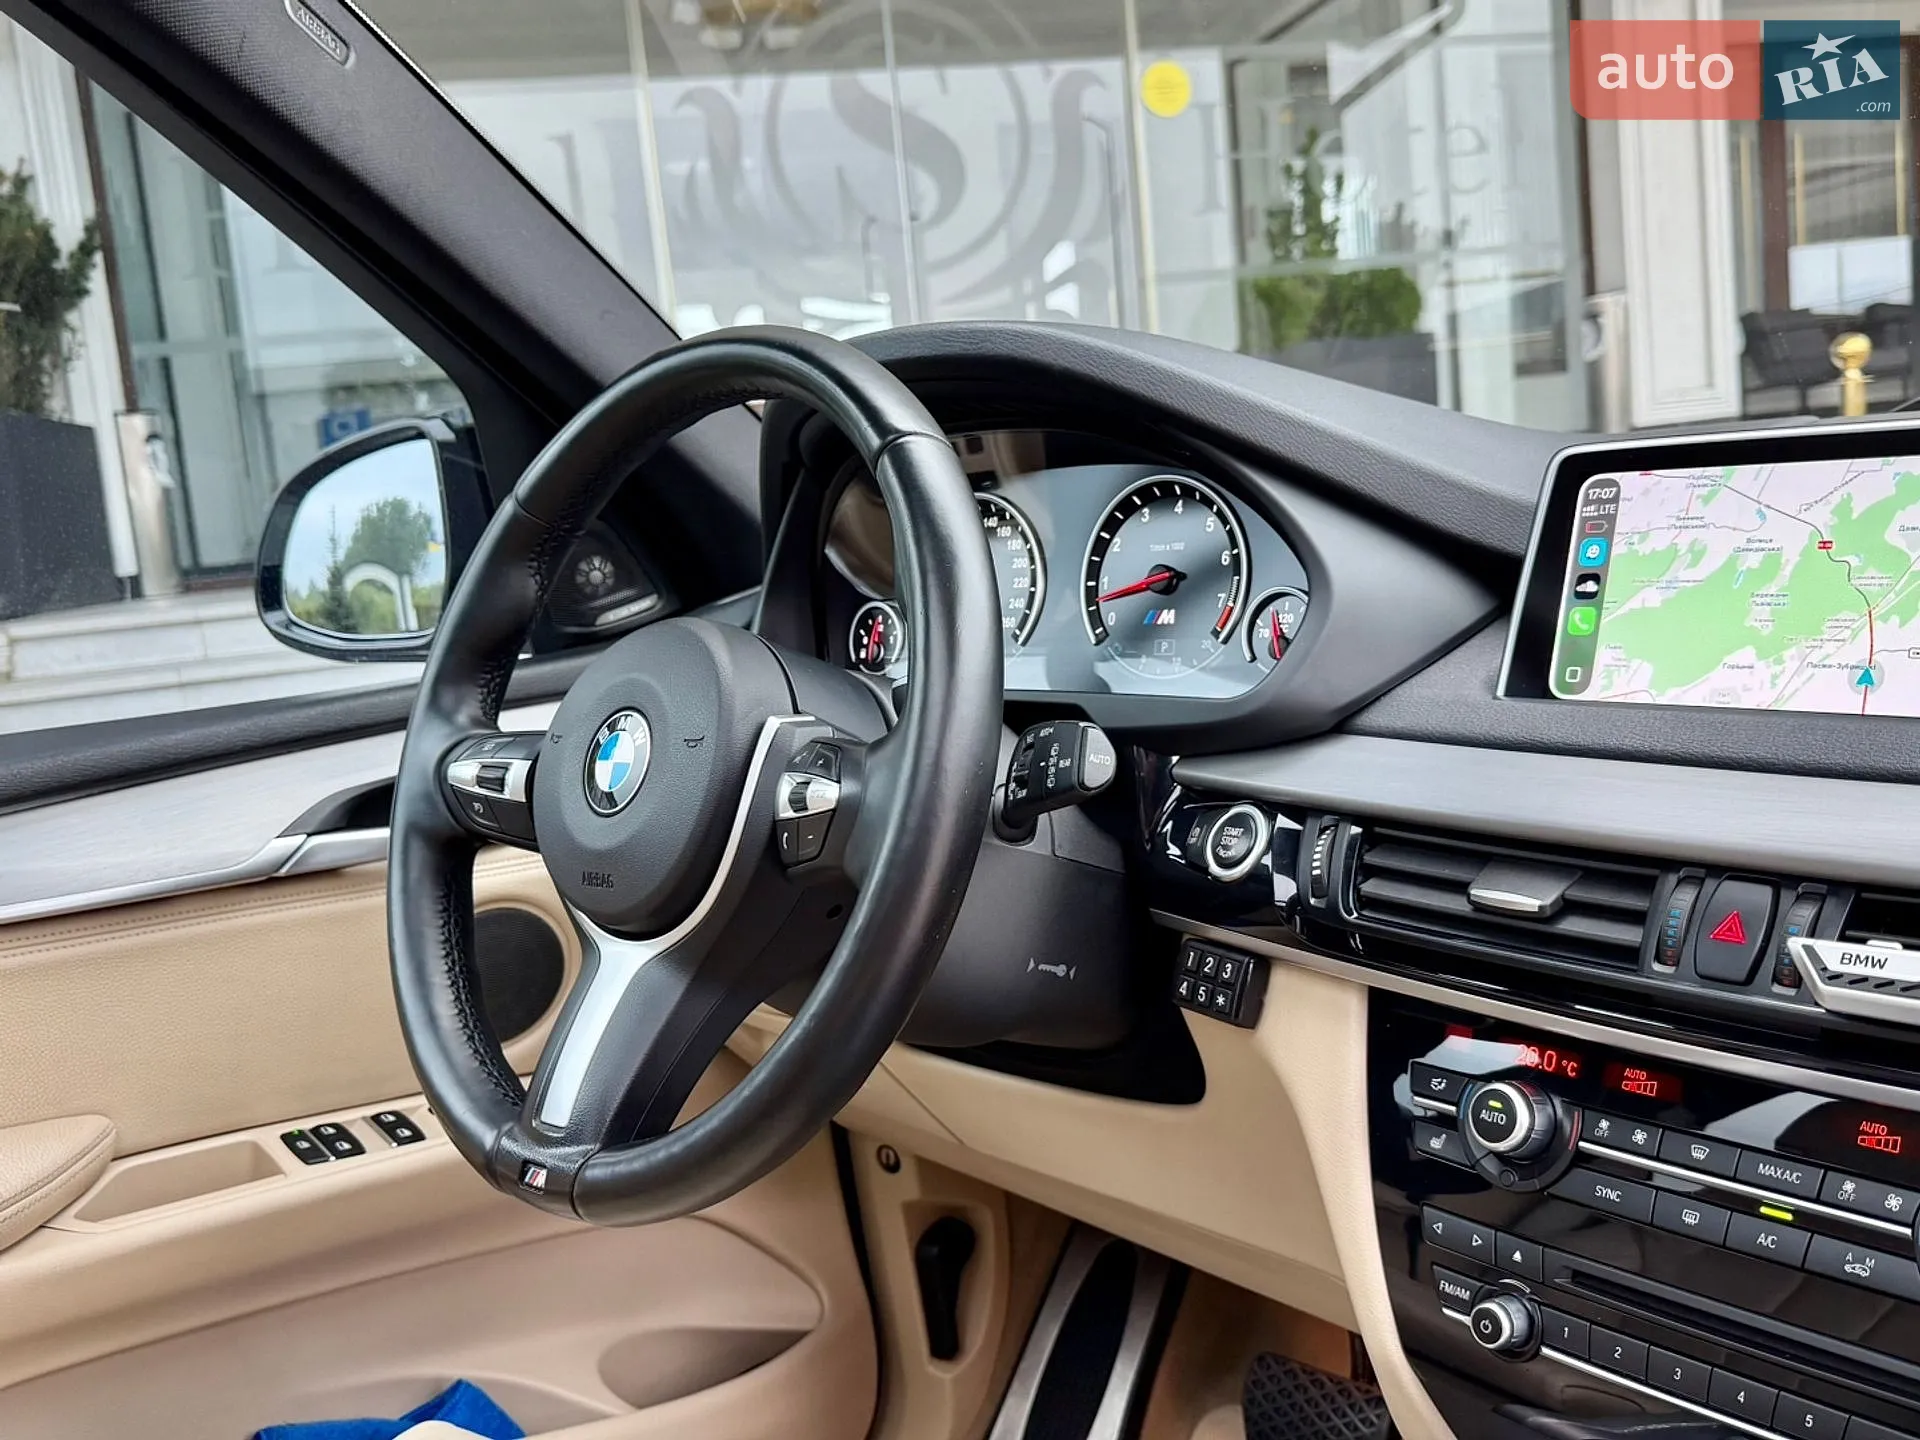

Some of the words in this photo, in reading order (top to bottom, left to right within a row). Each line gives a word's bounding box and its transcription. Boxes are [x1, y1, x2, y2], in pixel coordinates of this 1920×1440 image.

[1588, 487, 1617, 500] 17:07
[1174, 500, 1183, 515] 4
[1600, 504, 1617, 515] LTE
[983, 516, 998, 528] 140
[1141, 508, 1150, 522] 3
[1206, 517, 1214, 531] 5
[996, 526, 1012, 537] 160
[1007, 540, 1021, 550] 180
[1112, 538, 1121, 552] 2
[1012, 558, 1028, 568] 200
[1221, 551, 1230, 565] 6
[1012, 578, 1029, 588] 220
[1102, 576, 1109, 590] 1
[1009, 598, 1025, 609] 240
[1218, 593, 1226, 608] 7
[1108, 612, 1116, 626] 0
[1278, 613, 1294, 623] 120
[1258, 628, 1270, 638] 70
[1161, 641, 1168, 653] P
[599, 713, 646, 746] BMW
[1089, 754, 1110, 765] AUTO
[1223, 826, 1244, 836] START
[1220, 836, 1239, 846] STOP
[581, 871, 614, 889] AIRBAG
[1187, 951, 1194, 967] 1
[1203, 957, 1214, 973] 2
[1222, 963, 1232, 978] 3
[1840, 952, 1889, 970] BMW
[1179, 981, 1188, 996] 4
[1197, 986, 1207, 1002] 5
[1514, 1044, 1557, 1073] 20.0
[1561, 1060, 1579, 1077] °C
[1624, 1067, 1647, 1080] AUTO
[1479, 1109, 1507, 1125] AUTO
[1594, 1128, 1609, 1139] OFF
[1860, 1120, 1888, 1136] AUTO
[1758, 1163, 1784, 1180] MAX
[1783, 1168, 1802, 1184] A/C
[1594, 1185, 1622, 1202] SYNC
[1838, 1191, 1856, 1202] OFF
[1756, 1232, 1777, 1249] A/C
[1845, 1251, 1852, 1261] A
[1865, 1257, 1875, 1269] M
[1439, 1280, 1471, 1301] FM/AM
[1563, 1327, 1569, 1338] 1
[1614, 1346, 1622, 1359] 2
[1673, 1368, 1681, 1380] 3
[1737, 1391, 1745, 1404] 4
[1804, 1414, 1813, 1427] 5
